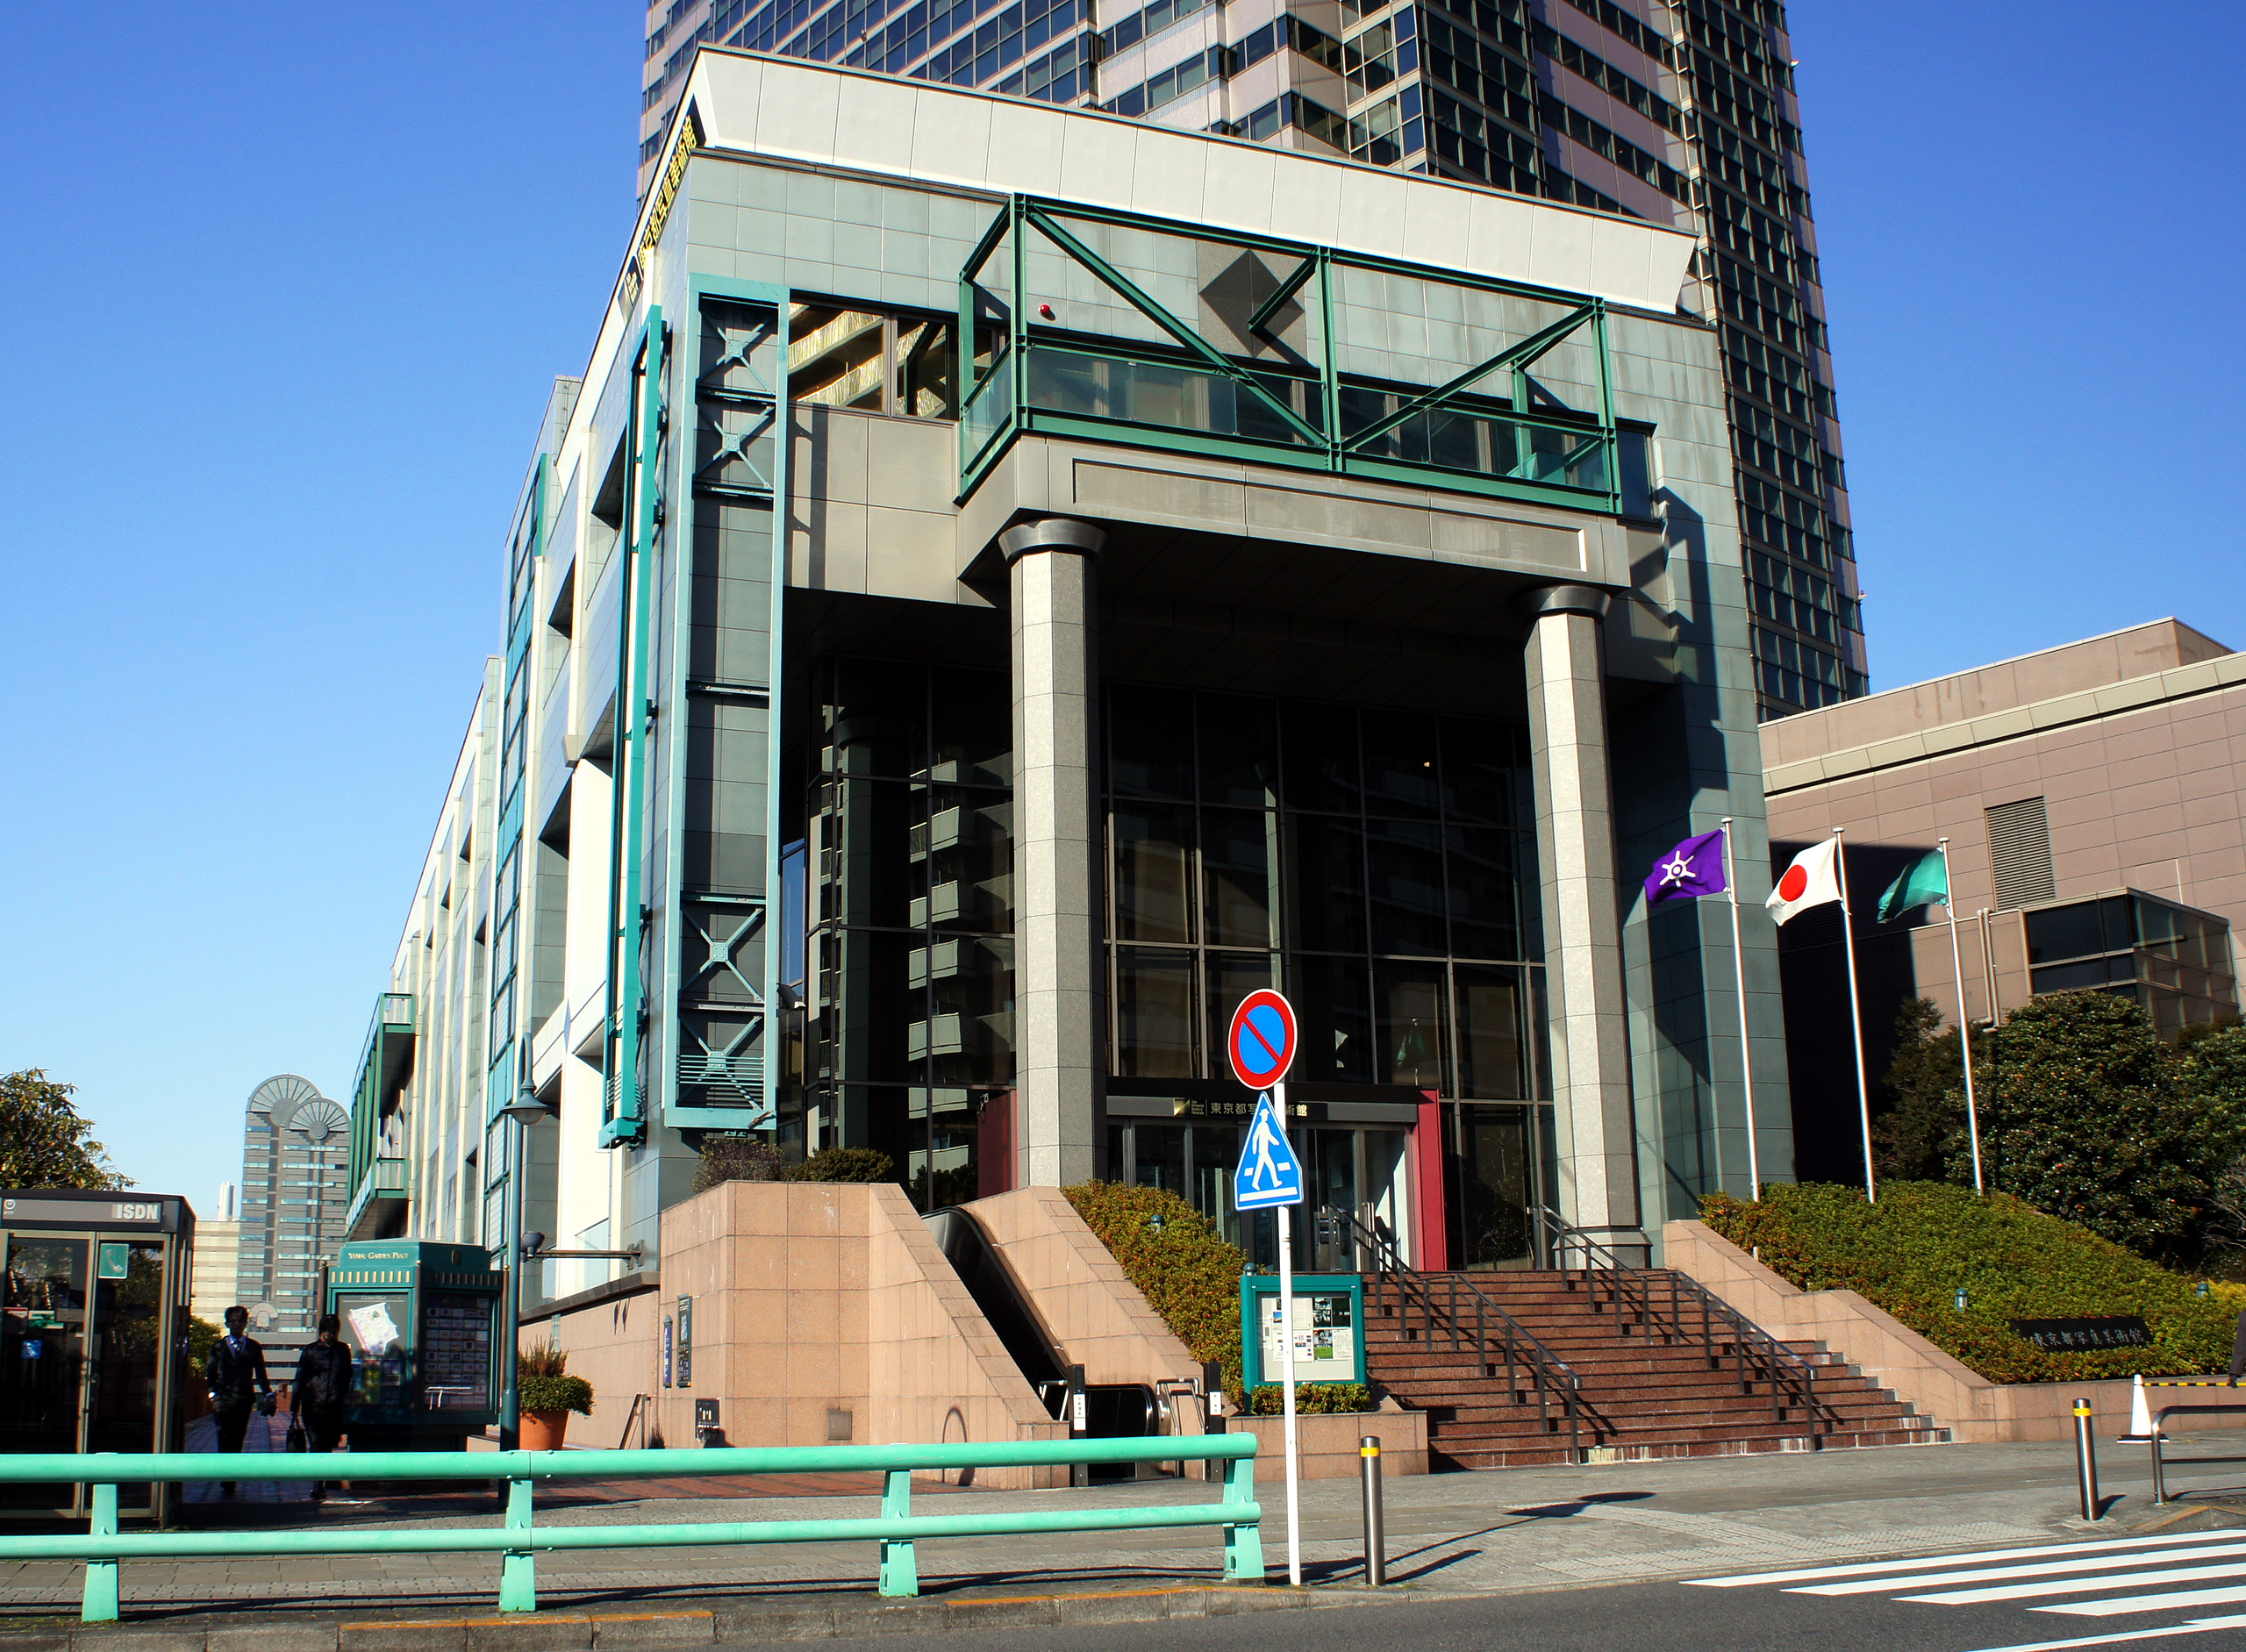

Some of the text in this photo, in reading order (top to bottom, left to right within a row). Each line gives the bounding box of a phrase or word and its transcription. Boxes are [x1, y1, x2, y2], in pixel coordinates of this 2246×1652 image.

[1210, 1102, 1307, 1117] 東京都写術館
[113, 1204, 158, 1219] ISDN
